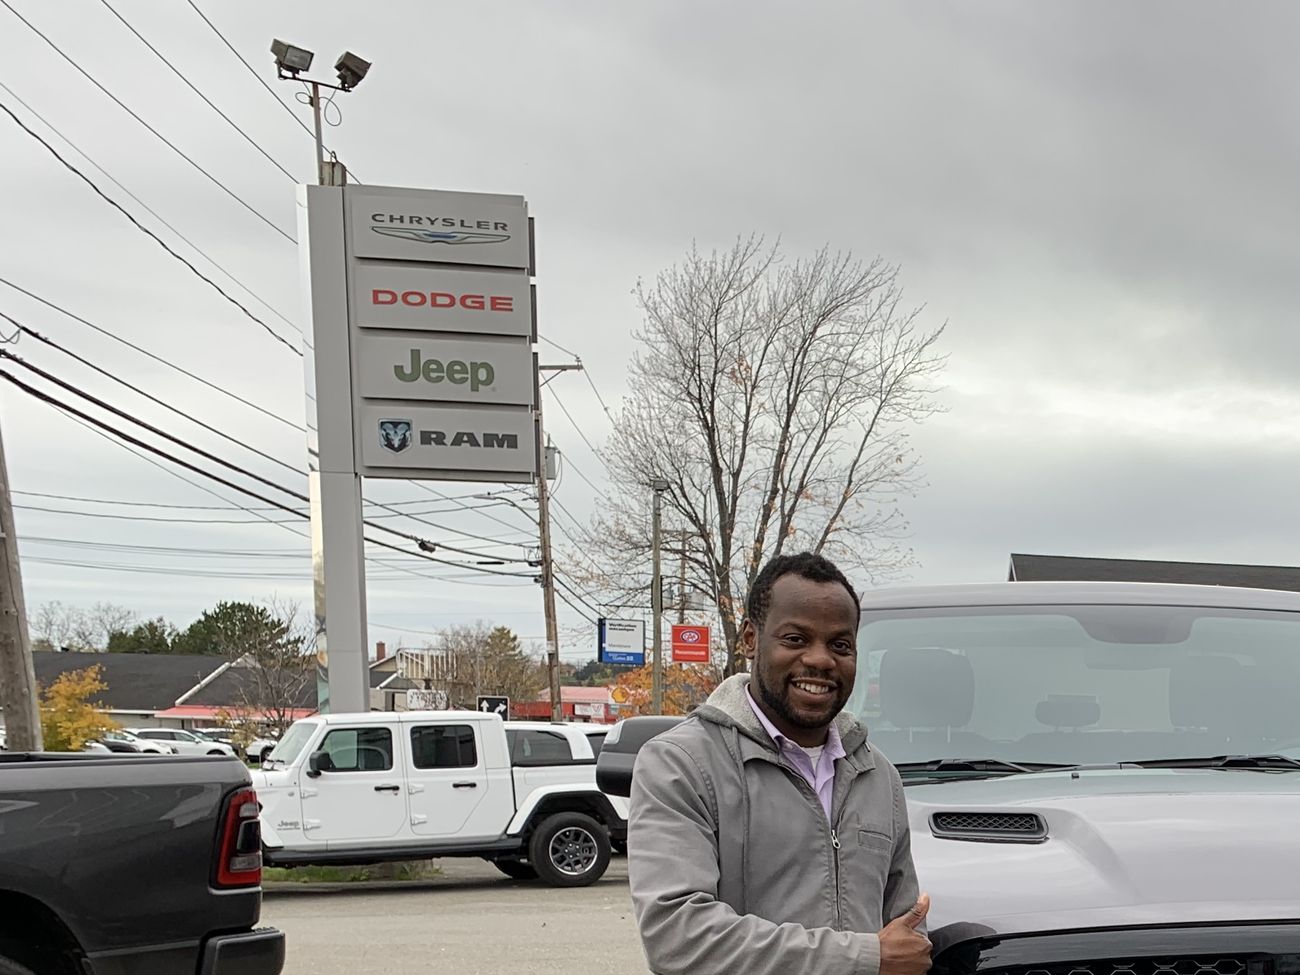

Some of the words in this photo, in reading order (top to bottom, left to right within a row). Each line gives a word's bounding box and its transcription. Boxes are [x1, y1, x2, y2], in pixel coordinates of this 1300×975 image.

[371, 213, 509, 231] CHRYSLER
[372, 289, 514, 312] DODGE
[393, 348, 495, 392] Jeep
[420, 430, 518, 449] RAM
